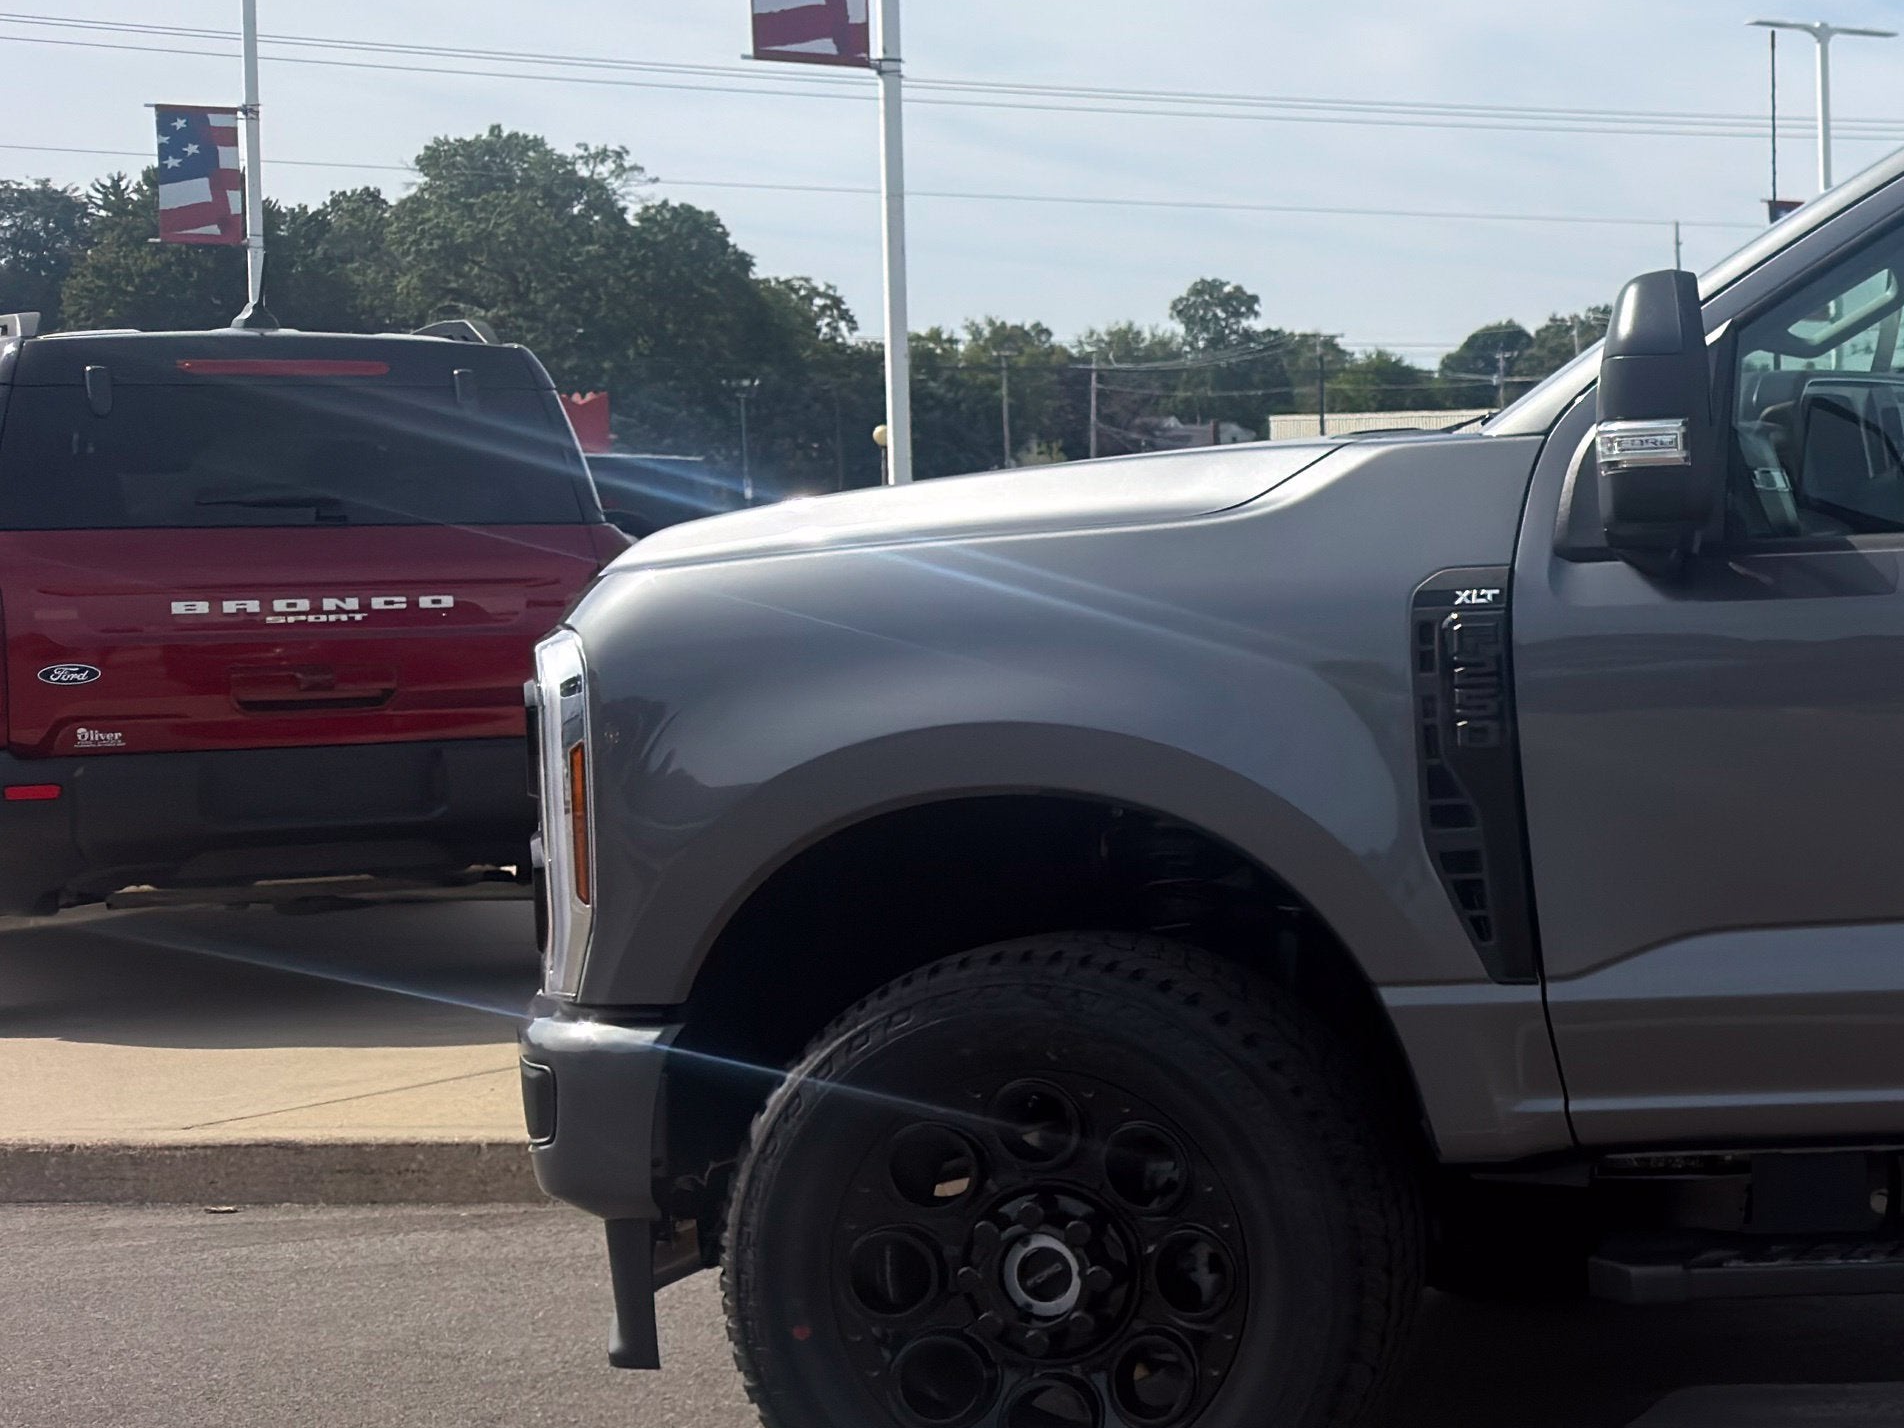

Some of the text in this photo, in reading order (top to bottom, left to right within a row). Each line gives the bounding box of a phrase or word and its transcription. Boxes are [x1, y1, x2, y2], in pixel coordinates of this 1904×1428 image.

[170, 594, 456, 615] BRONCO
[1453, 588, 1501, 605] XLT
[265, 613, 368, 624] SPORT
[76, 726, 123, 741] Oliver
